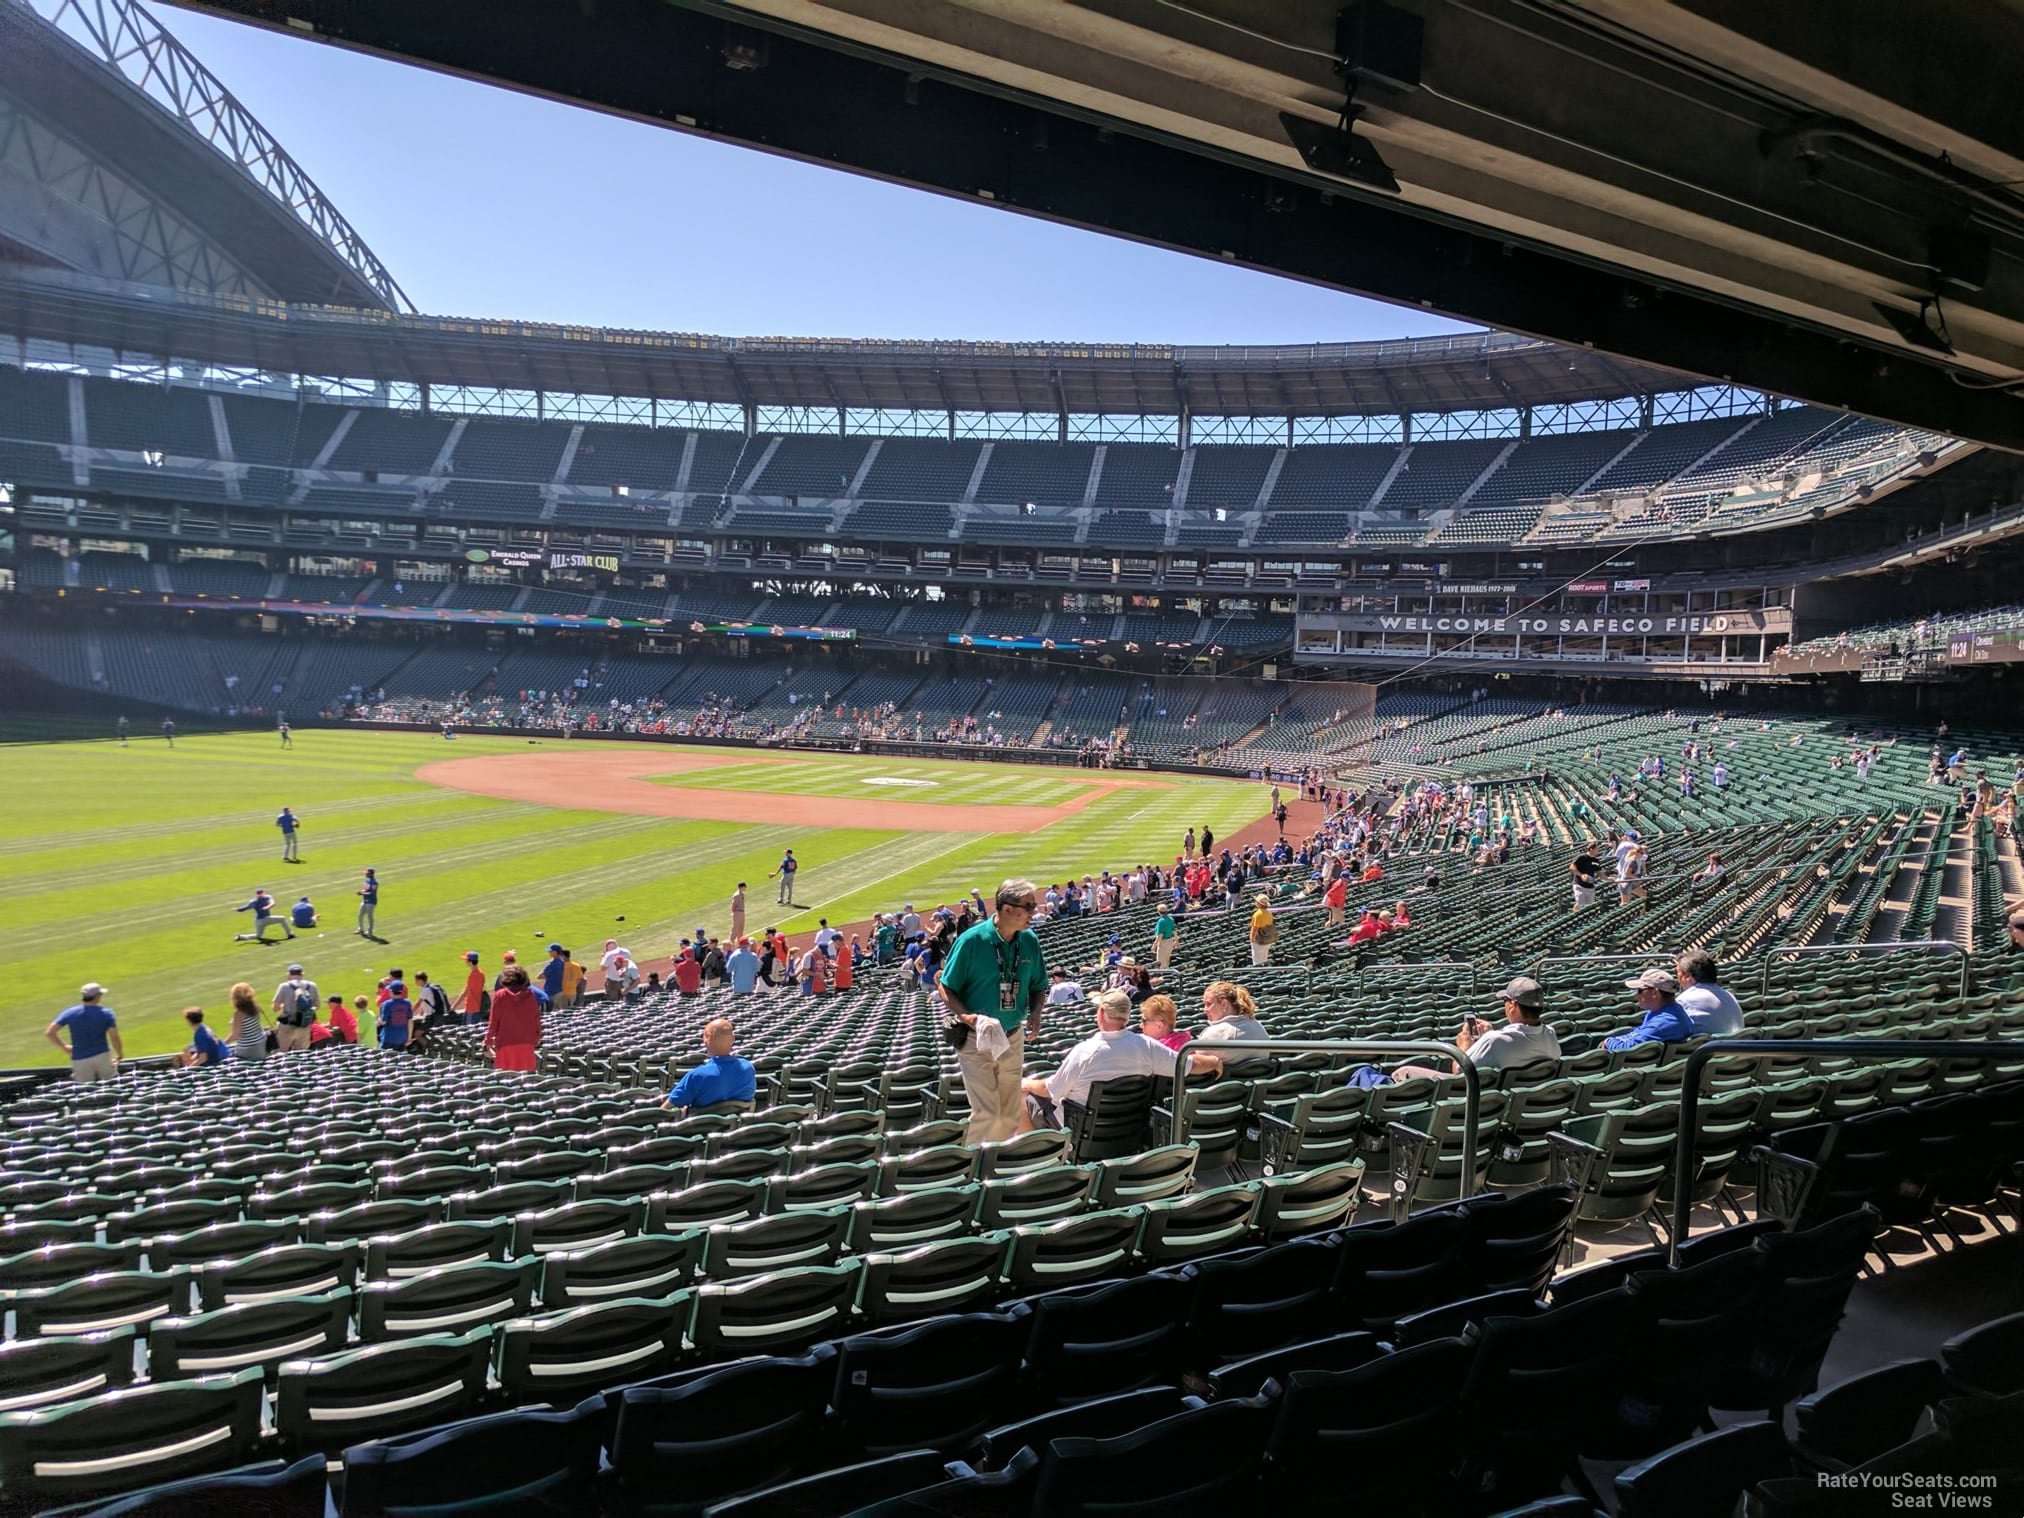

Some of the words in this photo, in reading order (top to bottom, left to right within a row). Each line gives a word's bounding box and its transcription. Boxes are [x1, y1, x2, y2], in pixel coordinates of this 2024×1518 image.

[595, 556, 618, 572] CLUB
[1380, 616, 1506, 632] WELCOME
[1518, 618, 1548, 632] TO
[1559, 618, 1653, 632] SAFECO
[1666, 616, 1729, 632] FIELD
[830, 631, 850, 639] 11:24
[1951, 642, 1968, 658] 11:24
